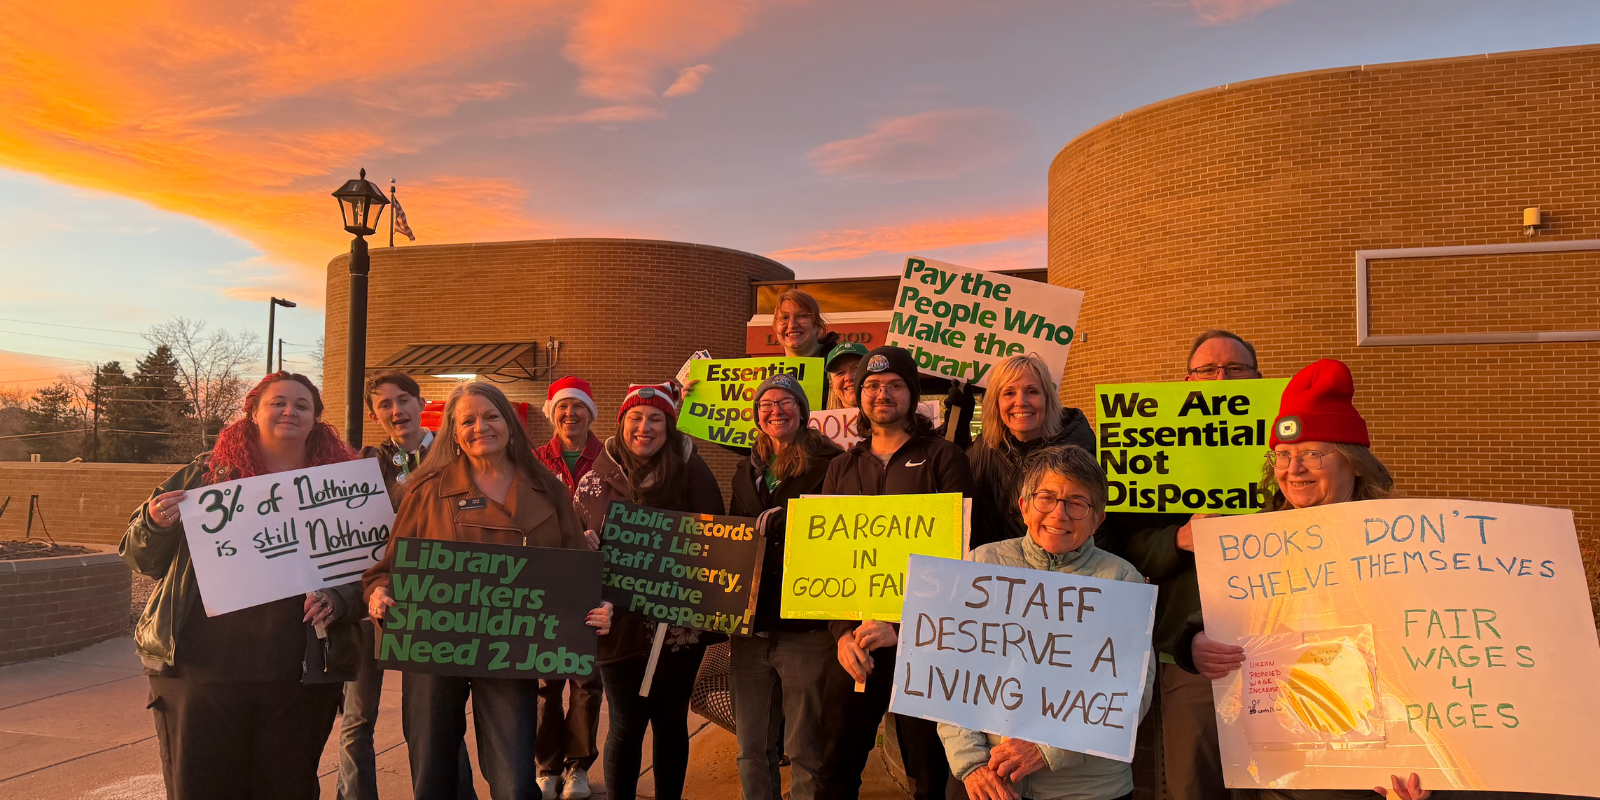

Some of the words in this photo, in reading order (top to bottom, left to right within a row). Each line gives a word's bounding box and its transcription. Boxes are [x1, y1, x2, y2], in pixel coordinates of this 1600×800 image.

[904, 257, 958, 295] Pay
[960, 272, 1012, 301] the
[898, 285, 997, 328] People
[1003, 306, 1074, 346] Who
[889, 311, 966, 349] Make
[973, 331, 1025, 358] the
[706, 361, 806, 382] Essential
[688, 402, 754, 426] Dispo
[1099, 392, 1158, 418] We
[1177, 391, 1250, 417] Are
[708, 425, 757, 446] Wag
[1099, 419, 1266, 448] Essential
[1099, 449, 1169, 475] Not
[198, 484, 245, 533] 3%
[256, 482, 283, 516] of
[294, 474, 384, 510] Nothing
[1105, 480, 1271, 512] Disposab
[216, 540, 237, 558] is
[252, 517, 298, 550] still
[305, 517, 390, 561] Nothing
[609, 502, 674, 531] Public
[678, 516, 755, 541] Records
[808, 512, 936, 541] BARGAIN
[1218, 525, 1324, 562] BOOKS
[1363, 509, 1498, 546] DON'T
[602, 523, 664, 550] Don't
[669, 536, 710, 557] Lie:
[395, 540, 529, 585] Library
[601, 544, 655, 570] Staff
[658, 556, 742, 593] Poverty,
[853, 547, 877, 569] IN
[1228, 561, 1340, 600] SHELVE
[1351, 550, 1556, 580] THEMSELVES
[392, 574, 546, 610] Workers
[601, 568, 703, 605] Executive
[792, 576, 857, 599] GOOD
[868, 572, 904, 598] FAI
[964, 575, 1102, 623] STAFF
[386, 602, 560, 640] Shouldn't
[629, 594, 753, 635] Prosperity!
[1404, 608, 1502, 640] FAIR
[379, 633, 481, 666] Need
[488, 641, 511, 671] 2
[515, 643, 596, 676] Jobs
[914, 612, 1073, 669] DESERVE
[1090, 636, 1117, 678] A
[1401, 644, 1536, 671] WAGES
[1248, 669, 1282, 680] PROPOSED
[1249, 660, 1275, 669] UNION
[904, 662, 1024, 711] LIVING
[1041, 685, 1129, 729] WAGE
[1248, 678, 1272, 687] WAGE
[1451, 675, 1474, 699] 4
[1404, 702, 1520, 733] PAGES
